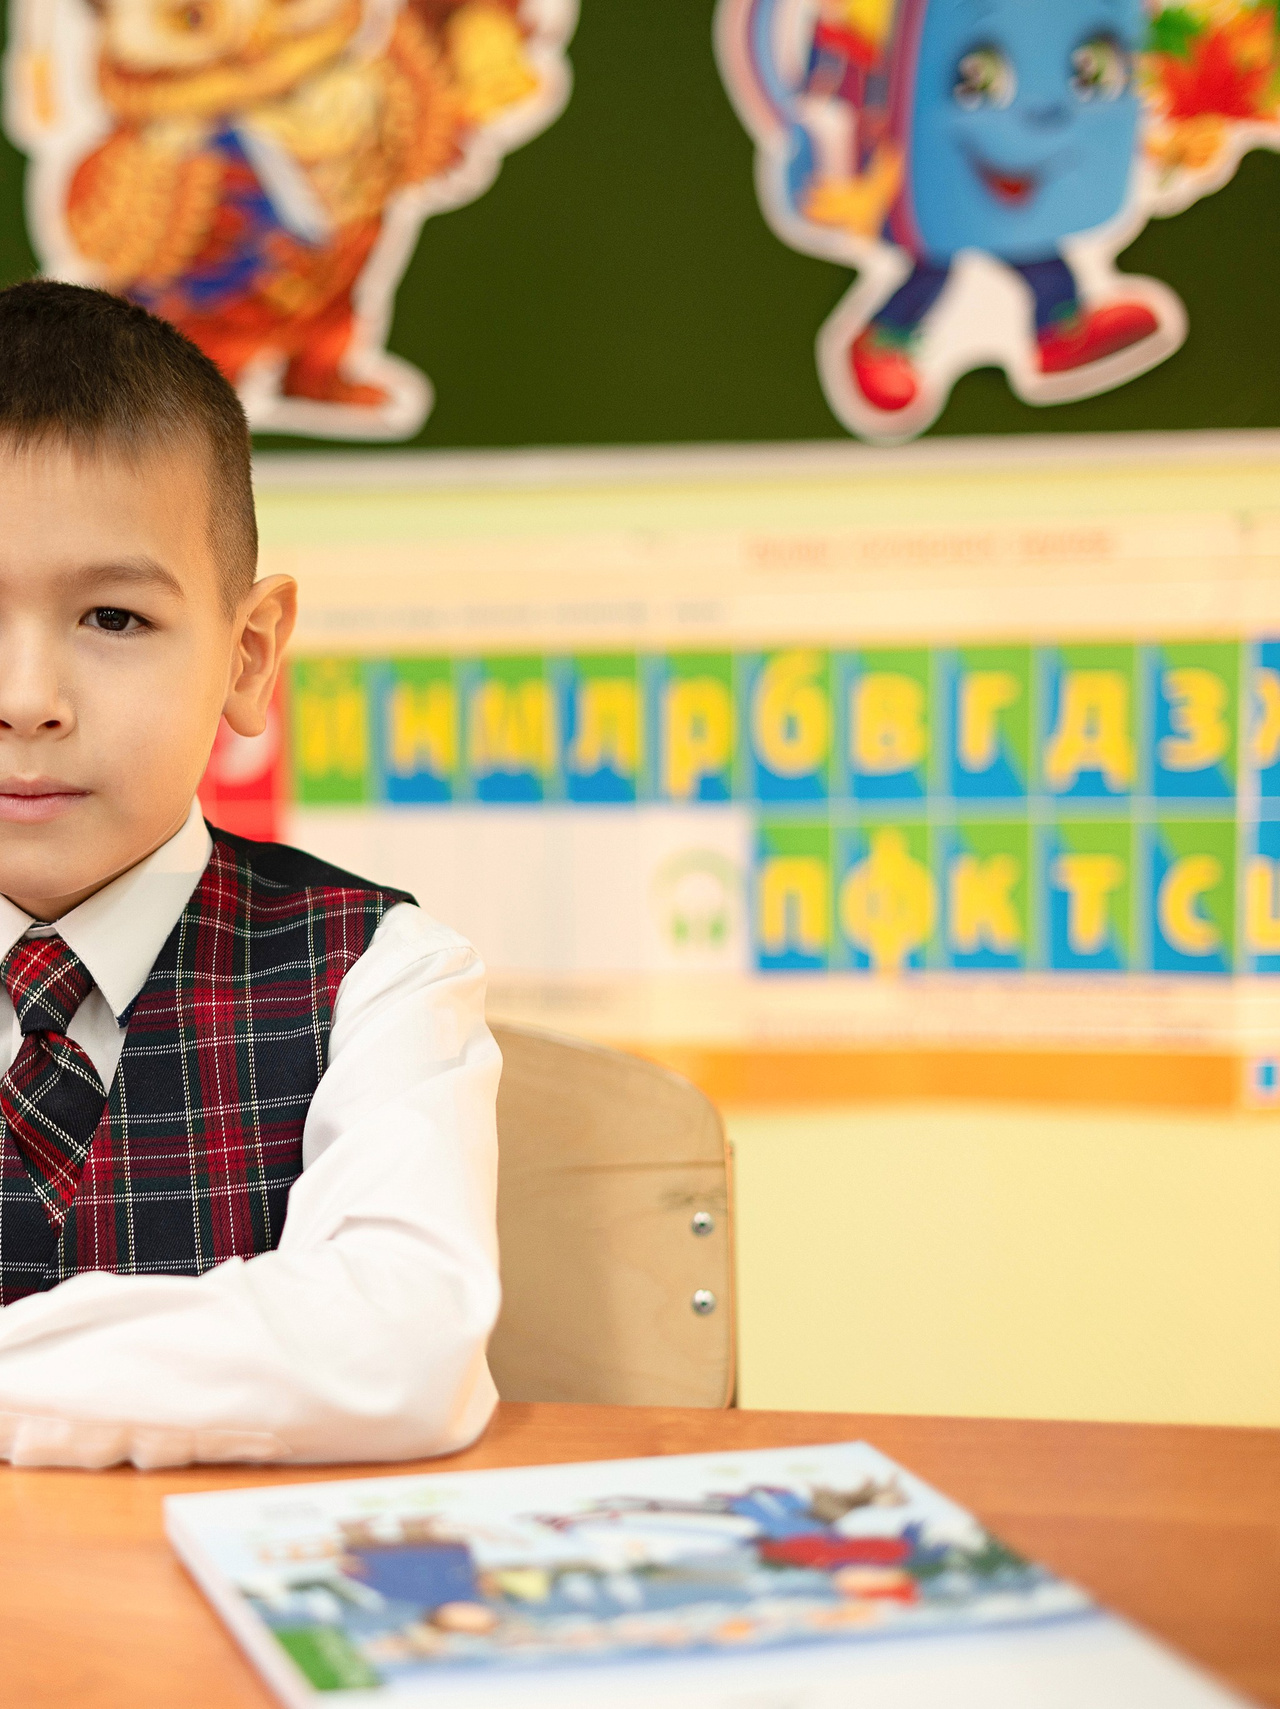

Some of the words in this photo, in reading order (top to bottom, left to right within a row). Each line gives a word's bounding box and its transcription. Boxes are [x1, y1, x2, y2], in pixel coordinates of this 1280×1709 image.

[572, 677, 639, 772] л
[663, 677, 734, 797] р
[752, 648, 832, 777] б
[850, 672, 929, 776] в
[958, 672, 1019, 771] г
[1044, 668, 1136, 793] д
[759, 856, 828, 956] п
[839, 825, 937, 981] ф
